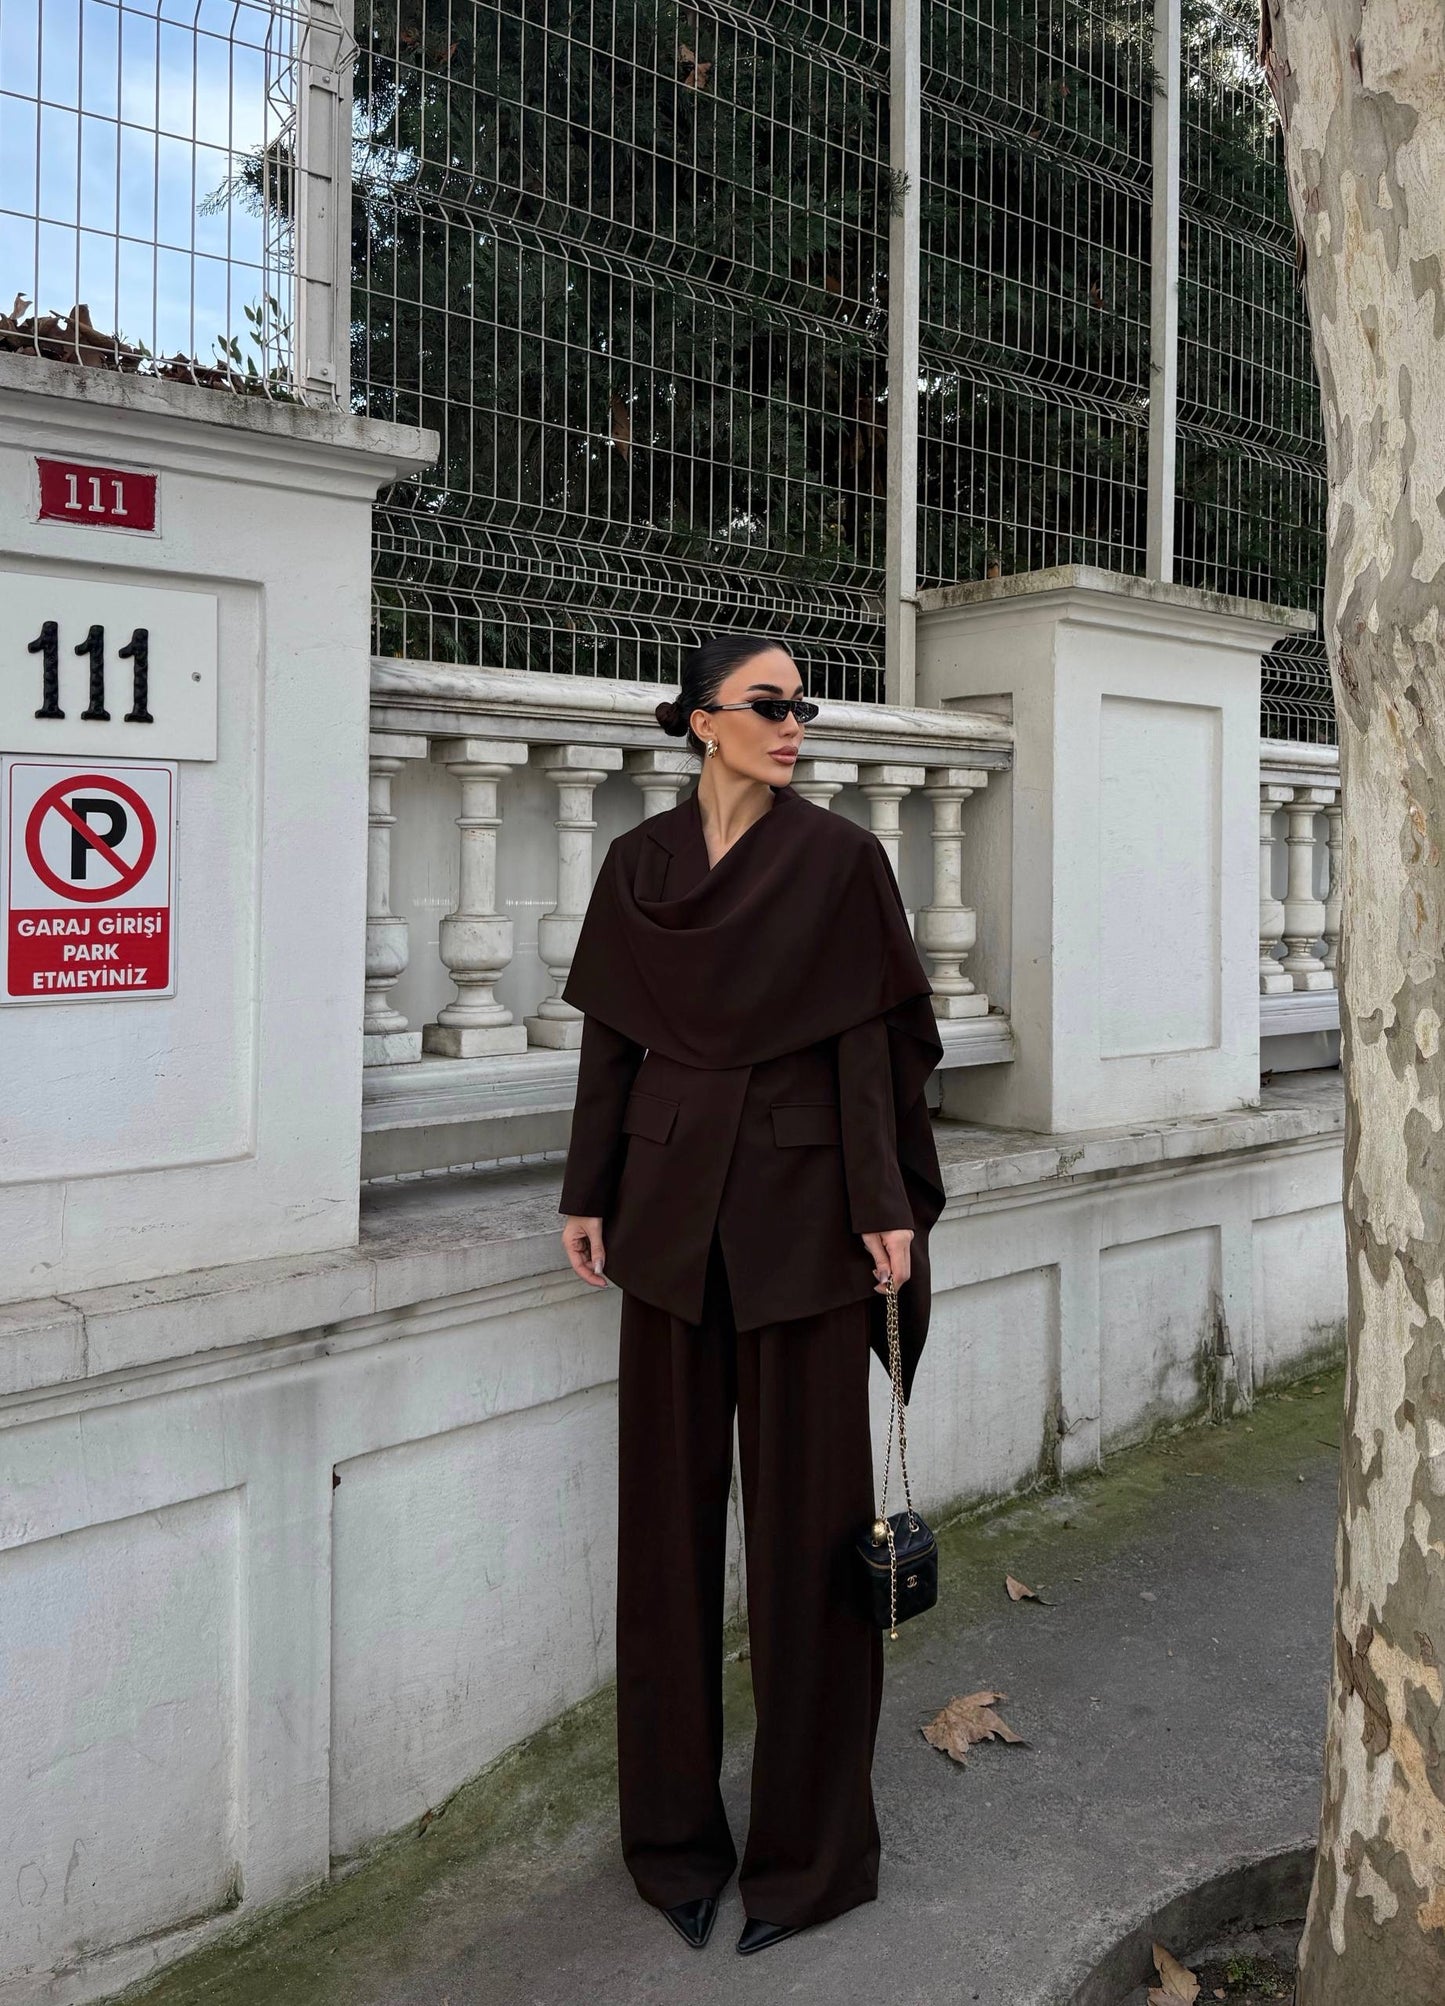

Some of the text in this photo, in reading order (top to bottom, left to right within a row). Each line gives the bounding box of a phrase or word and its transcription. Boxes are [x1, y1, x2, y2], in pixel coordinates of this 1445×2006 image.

[65, 473, 128, 515] 111
[27, 620, 154, 723] 111
[70, 798, 127, 879] P
[17, 911, 162, 939] GARAJ GİRİŞİ
[63, 943, 119, 962] PARK
[33, 963, 148, 989] ETMEYİNİZ
